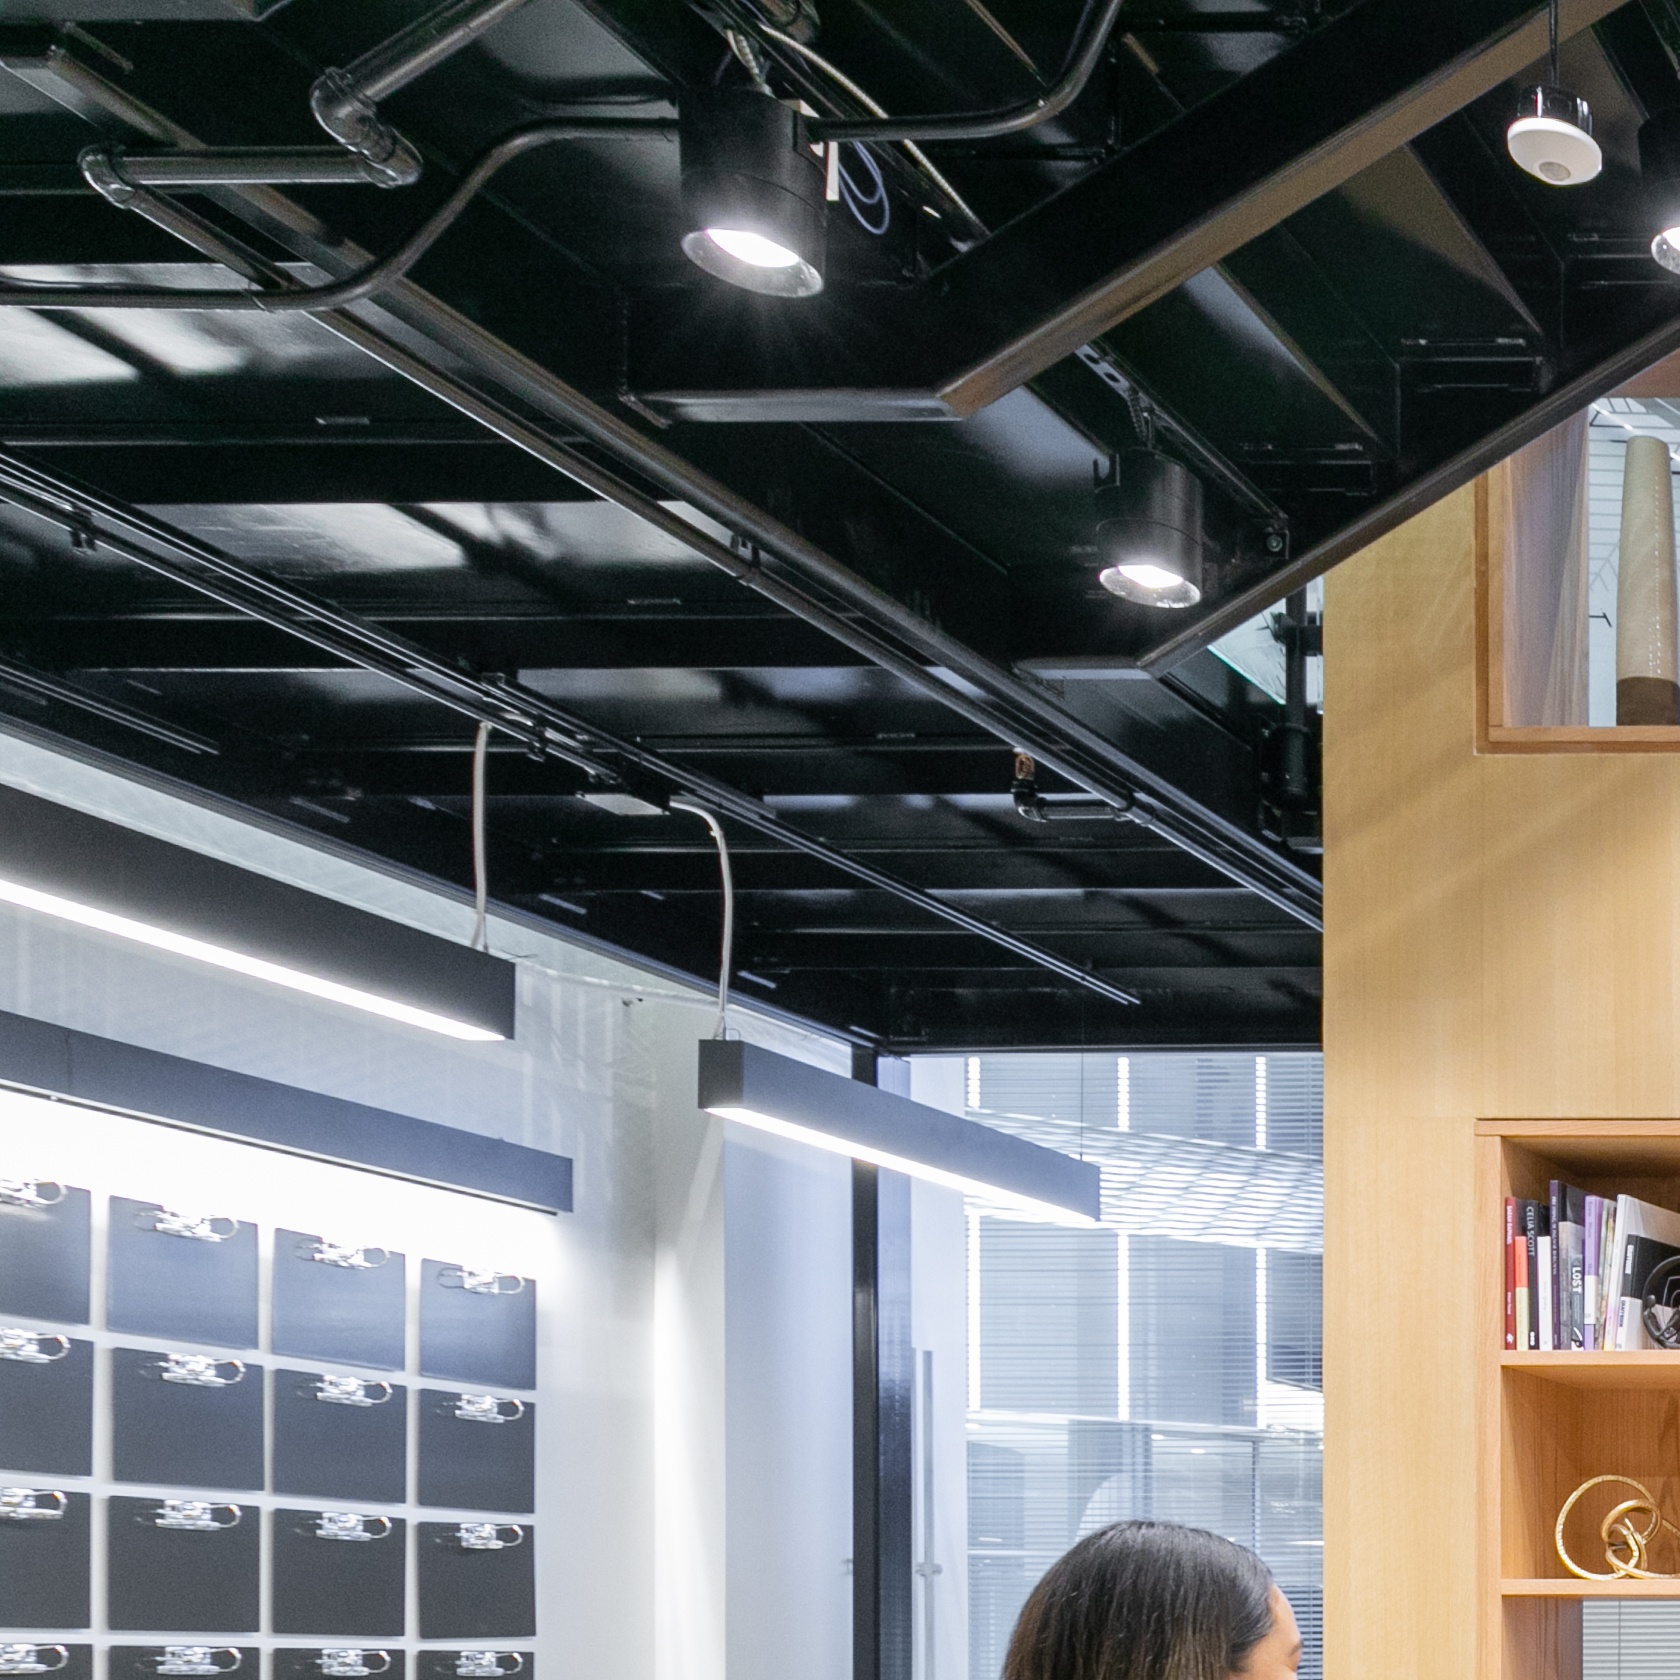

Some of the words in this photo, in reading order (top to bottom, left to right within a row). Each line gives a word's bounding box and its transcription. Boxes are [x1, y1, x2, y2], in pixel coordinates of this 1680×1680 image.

[1526, 1206, 1534, 1232] CELIA
[1526, 1231, 1535, 1257] SCOTT
[1571, 1266, 1582, 1293] LOST
